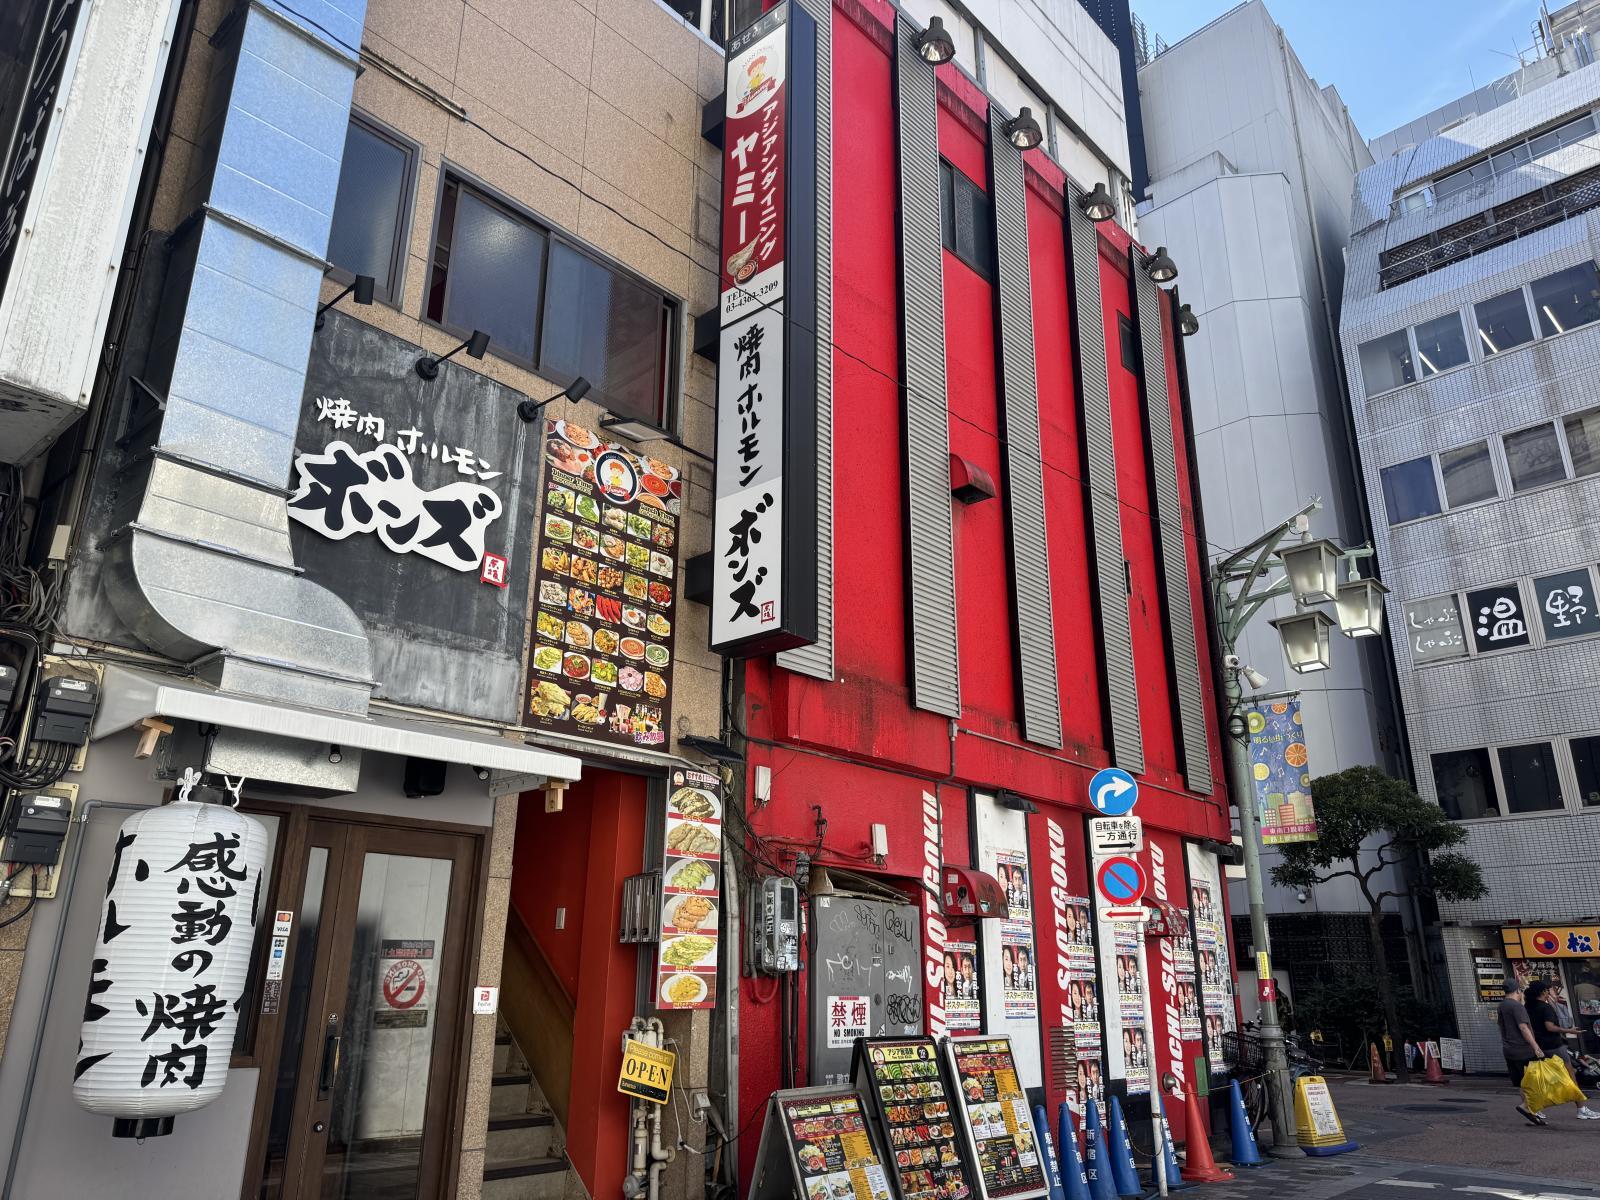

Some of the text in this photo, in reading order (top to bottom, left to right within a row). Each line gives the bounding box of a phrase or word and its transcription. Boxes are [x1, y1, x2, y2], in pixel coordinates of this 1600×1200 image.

[731, 131, 759, 244] ヤミー
[760, 100, 778, 261] アジアンダイニング
[316, 396, 504, 481] 焼肉 ホルモン
[733, 323, 765, 487] 焼肉 ホルモン
[287, 449, 496, 562] ボンズ
[724, 492, 774, 623] ボンズ
[1096, 820, 1137, 831] 自転車を除く
[1096, 830, 1137, 841] 一方通行
[135, 832, 248, 1090] 感動の焼肉
[1567, 931, 1600, 953] 松
[831, 1001, 867, 1027] 禁煙
[834, 1029, 865, 1037] NO SMOKING
[1086, 1129, 1098, 1180] 新宿区
